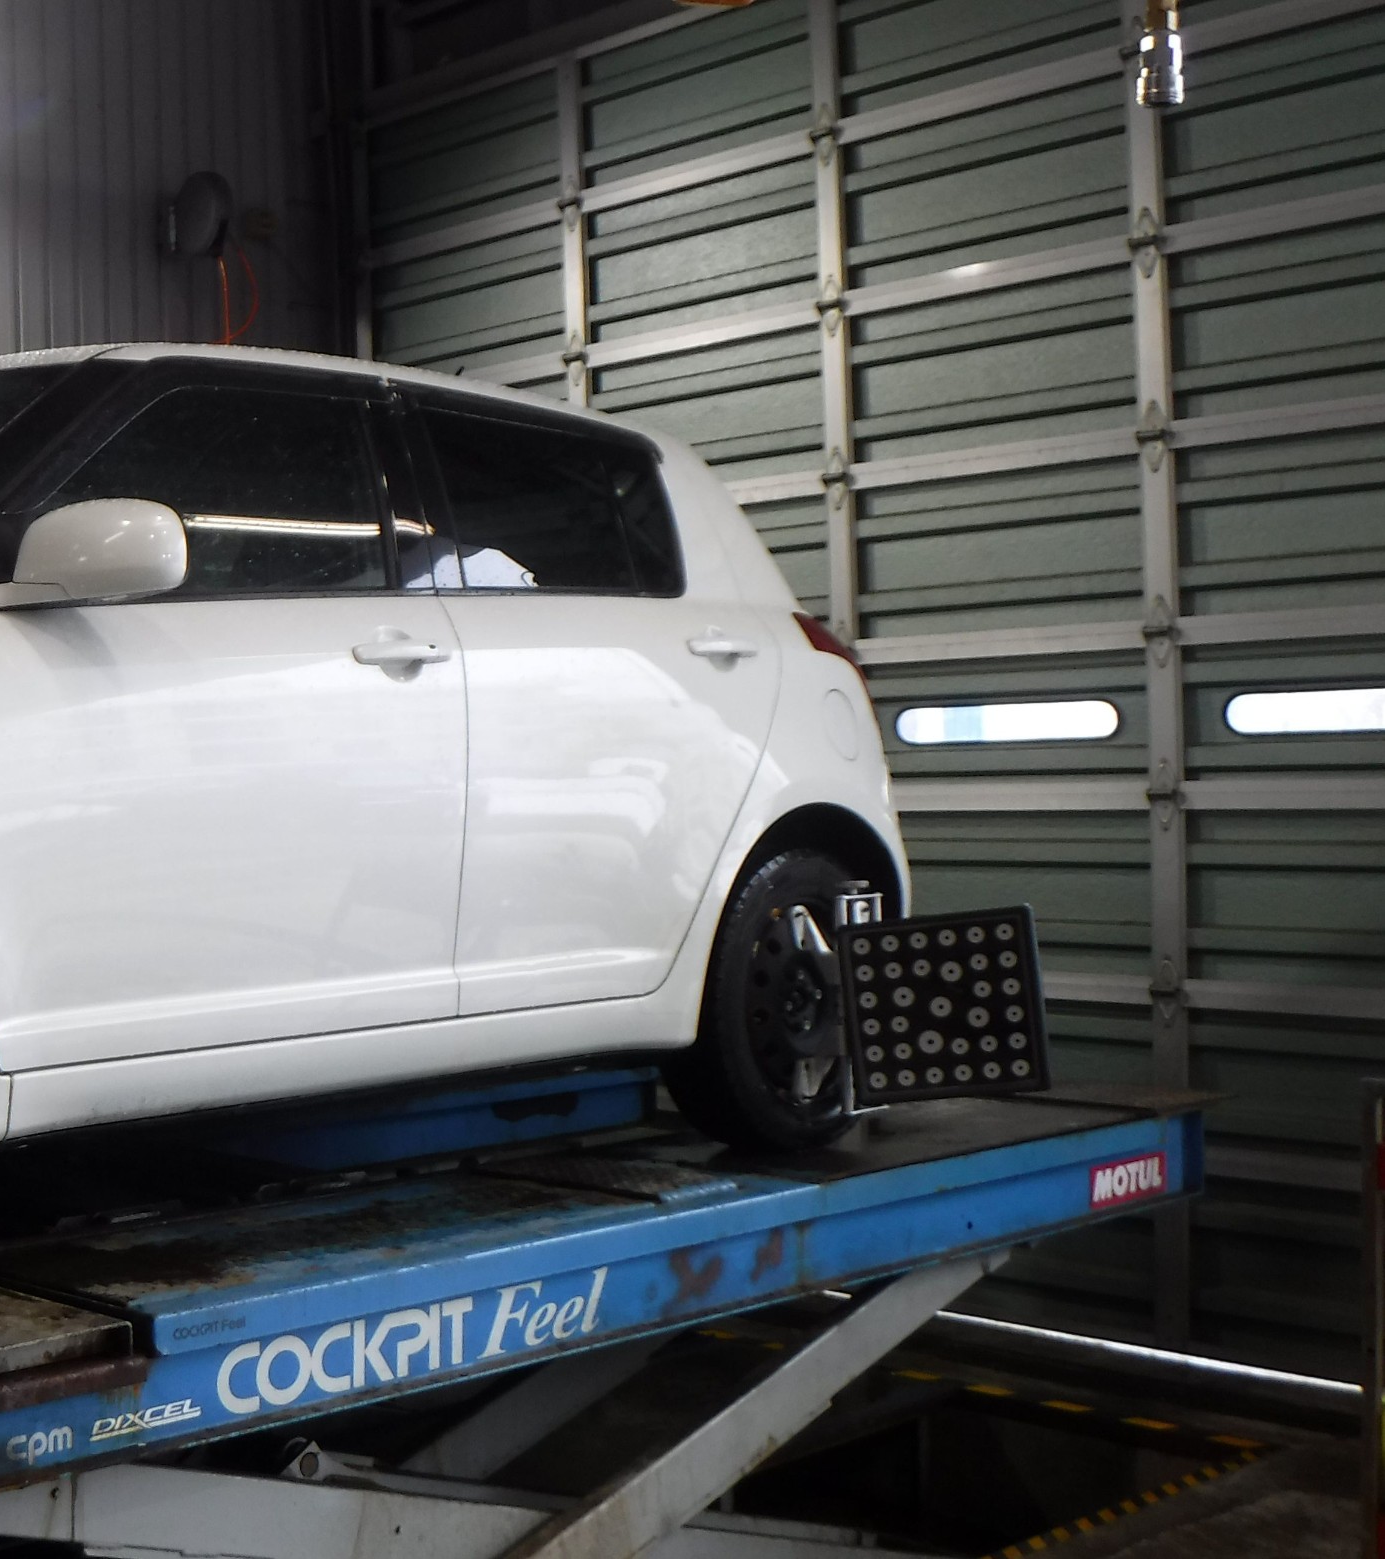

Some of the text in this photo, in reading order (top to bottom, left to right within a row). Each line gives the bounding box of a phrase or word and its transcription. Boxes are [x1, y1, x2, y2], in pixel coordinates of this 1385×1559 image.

[1093, 1156, 1163, 1202] MOTUL
[217, 1266, 608, 1415] COCKPIT Feel
[90, 1398, 202, 1437] DIXCEL
[6, 1425, 73, 1466] cpm
